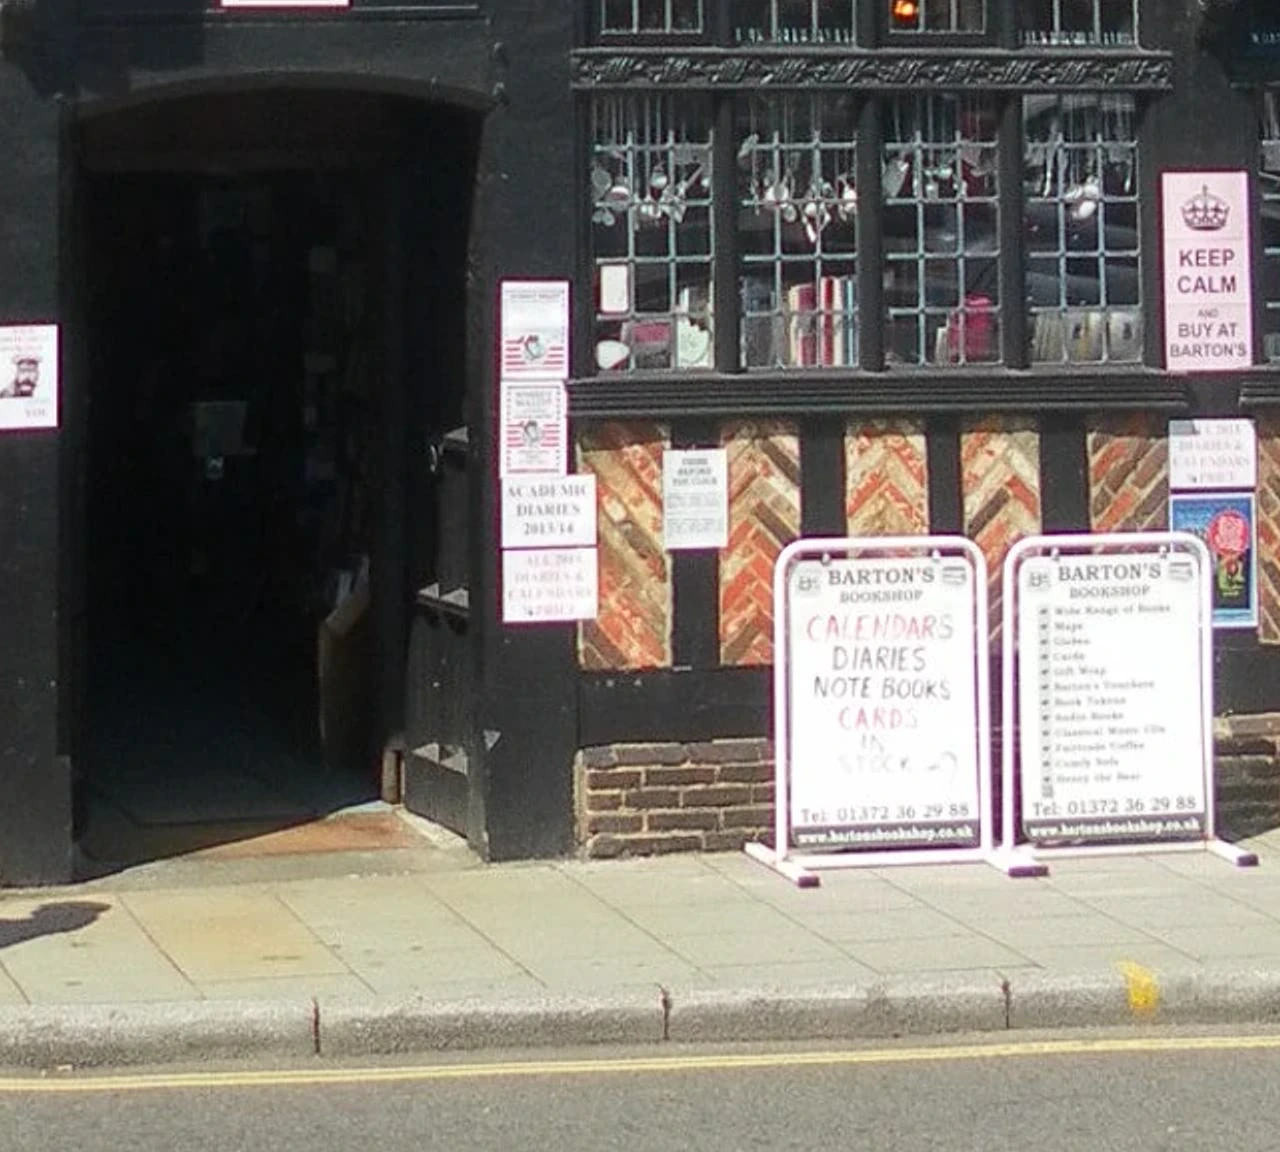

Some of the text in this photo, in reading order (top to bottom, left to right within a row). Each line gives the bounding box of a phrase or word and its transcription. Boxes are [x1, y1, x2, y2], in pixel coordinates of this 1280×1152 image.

[1179, 248, 1235, 267] KEEP
[1177, 275, 1237, 294] CALM
[1197, 309, 1219, 319] AND
[1178, 322, 1239, 338] BUY AT
[1169, 341, 1247, 358] BARTON'S
[828, 567, 935, 586] BARTON'S
[1058, 562, 1162, 582] BARTON'S
[840, 589, 924, 603] BOOKSHOP
[1069, 584, 1151, 599] BOOKSHOP
[806, 613, 954, 642] CALENDARS
[832, 645, 927, 672] DIARIES
[814, 675, 952, 701] NOTE BOOKS
[837, 705, 918, 731] CARDS
[836, 805, 889, 822] 01372
[1067, 798, 1119, 814] 01372
[1125, 797, 1145, 813] 36
[1151, 795, 1171, 812] 29
[1175, 794, 1197, 810] 88
